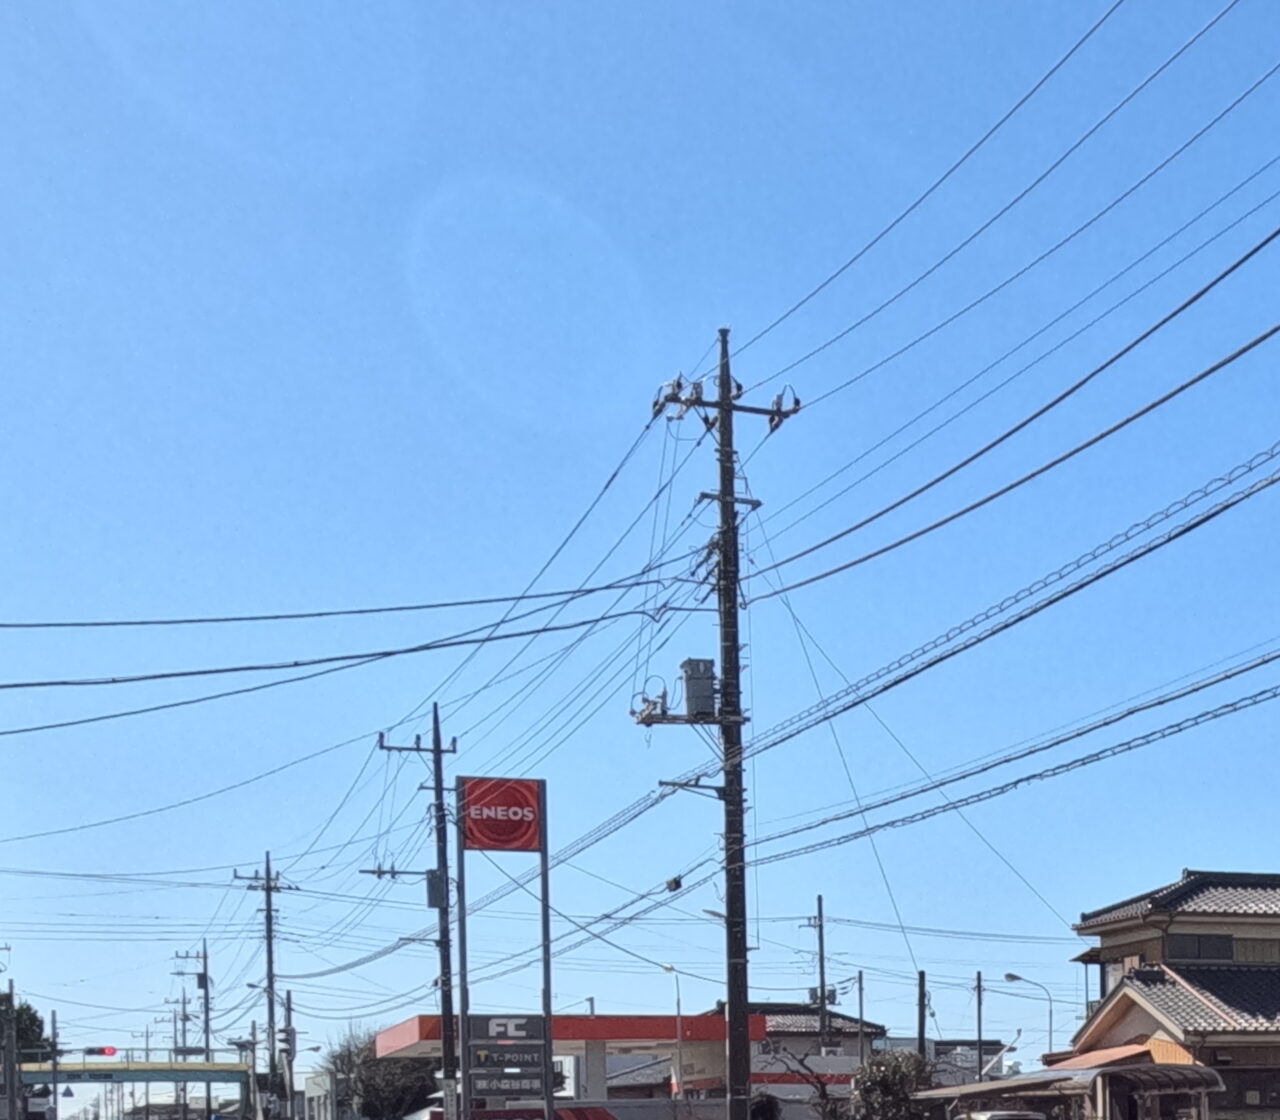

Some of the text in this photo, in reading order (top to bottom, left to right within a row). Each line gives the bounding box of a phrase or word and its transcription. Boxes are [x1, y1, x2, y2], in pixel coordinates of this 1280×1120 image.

[470, 805, 534, 821] ENEOS
[488, 1018, 527, 1036] FC
[491, 1053, 539, 1062] T-POINT
